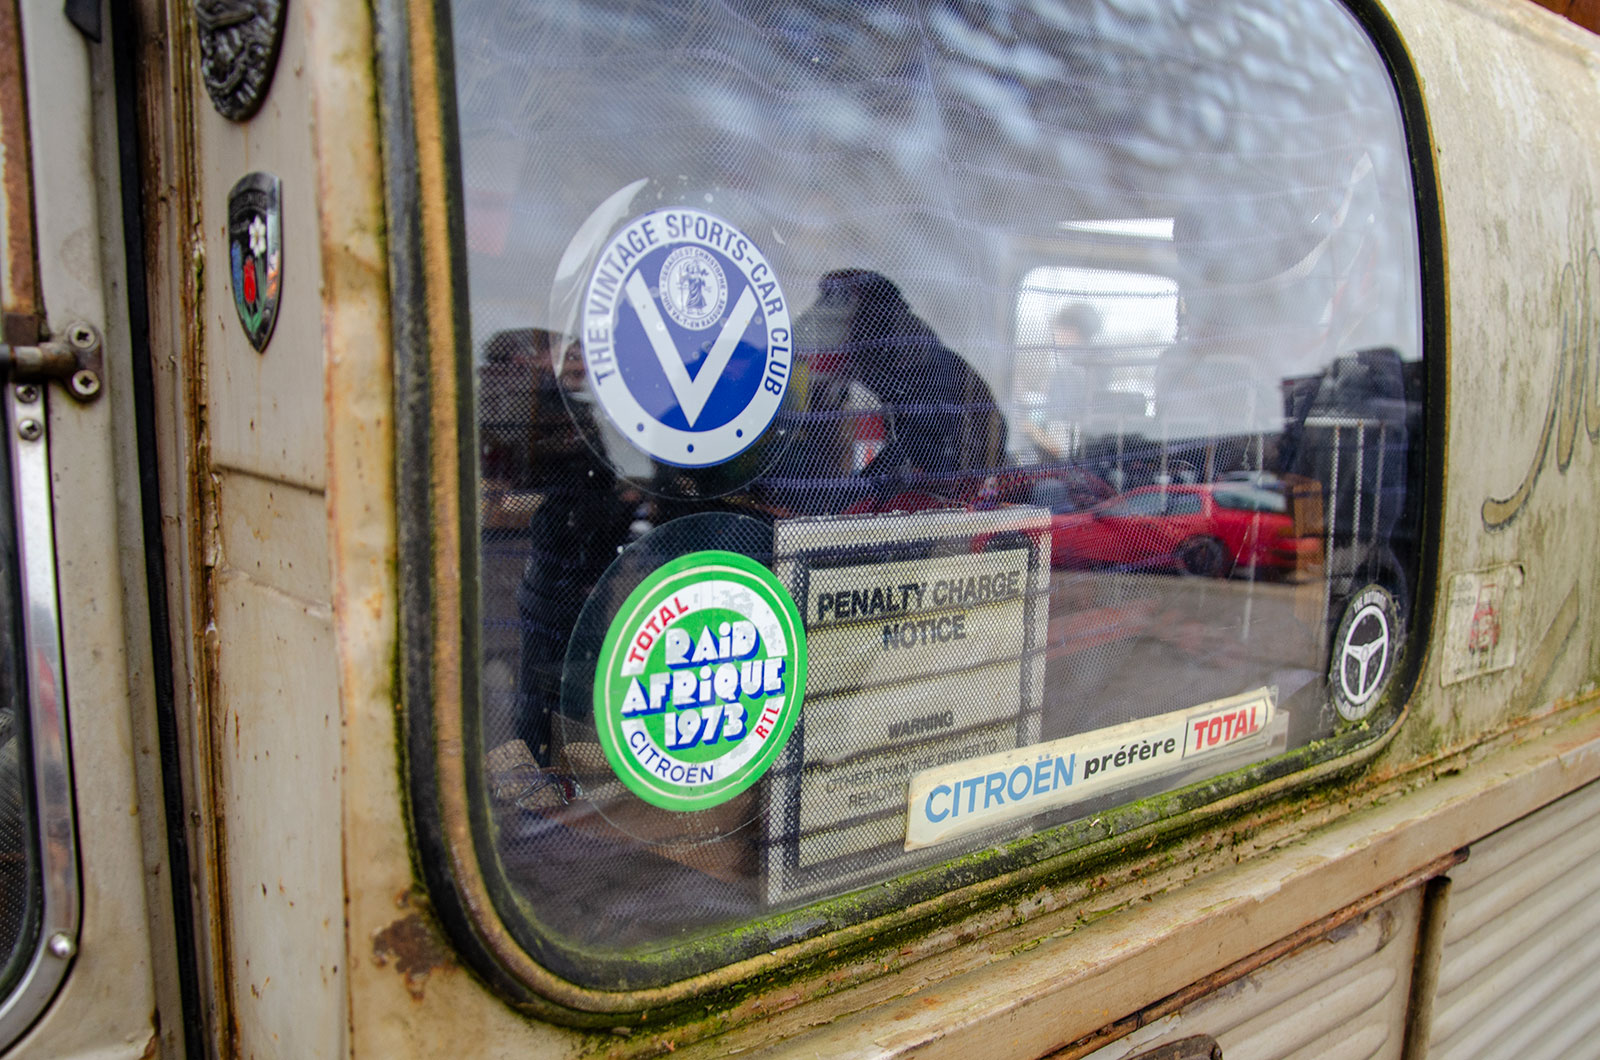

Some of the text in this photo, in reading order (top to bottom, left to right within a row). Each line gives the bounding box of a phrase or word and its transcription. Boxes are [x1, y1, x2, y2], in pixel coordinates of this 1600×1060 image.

[588, 214, 789, 396] THE VINTAGE SPORTS-CAR CLUB
[817, 571, 1022, 621] PENALTY CHARGE
[628, 597, 689, 665] TOTAL
[882, 615, 967, 650] NOTICE
[664, 702, 748, 751] 1973
[755, 706, 780, 739] RTL
[887, 710, 953, 738] WARNING
[925, 705, 1259, 823] CITROËN préfère TOTAL
